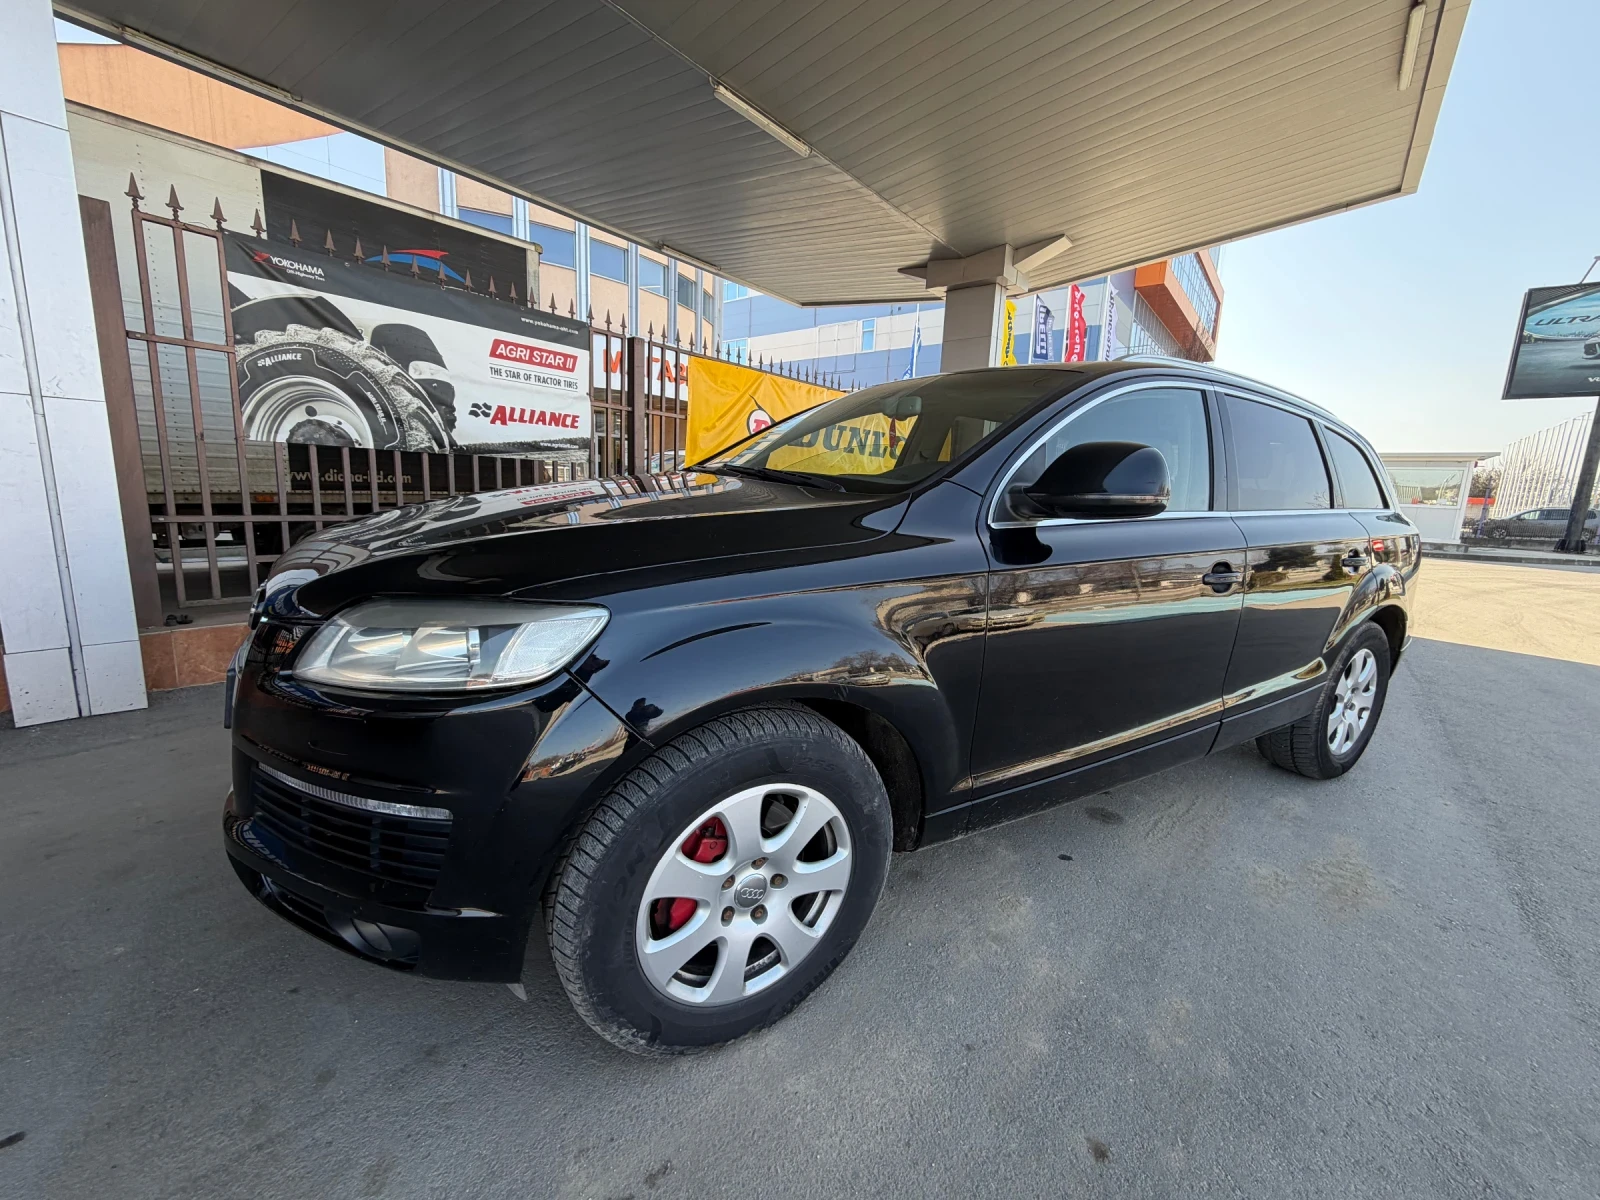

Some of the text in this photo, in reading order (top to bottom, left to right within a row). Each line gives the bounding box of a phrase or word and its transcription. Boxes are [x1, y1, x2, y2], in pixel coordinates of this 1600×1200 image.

[270, 255, 325, 277] YOKOHAMA
[265, 353, 302, 367] ALLIANCE
[495, 343, 574, 370] AGRI STAR II
[489, 366, 579, 391] THE STAR OF TRACTOR TIRES
[489, 405, 580, 430] ALLIANCE
